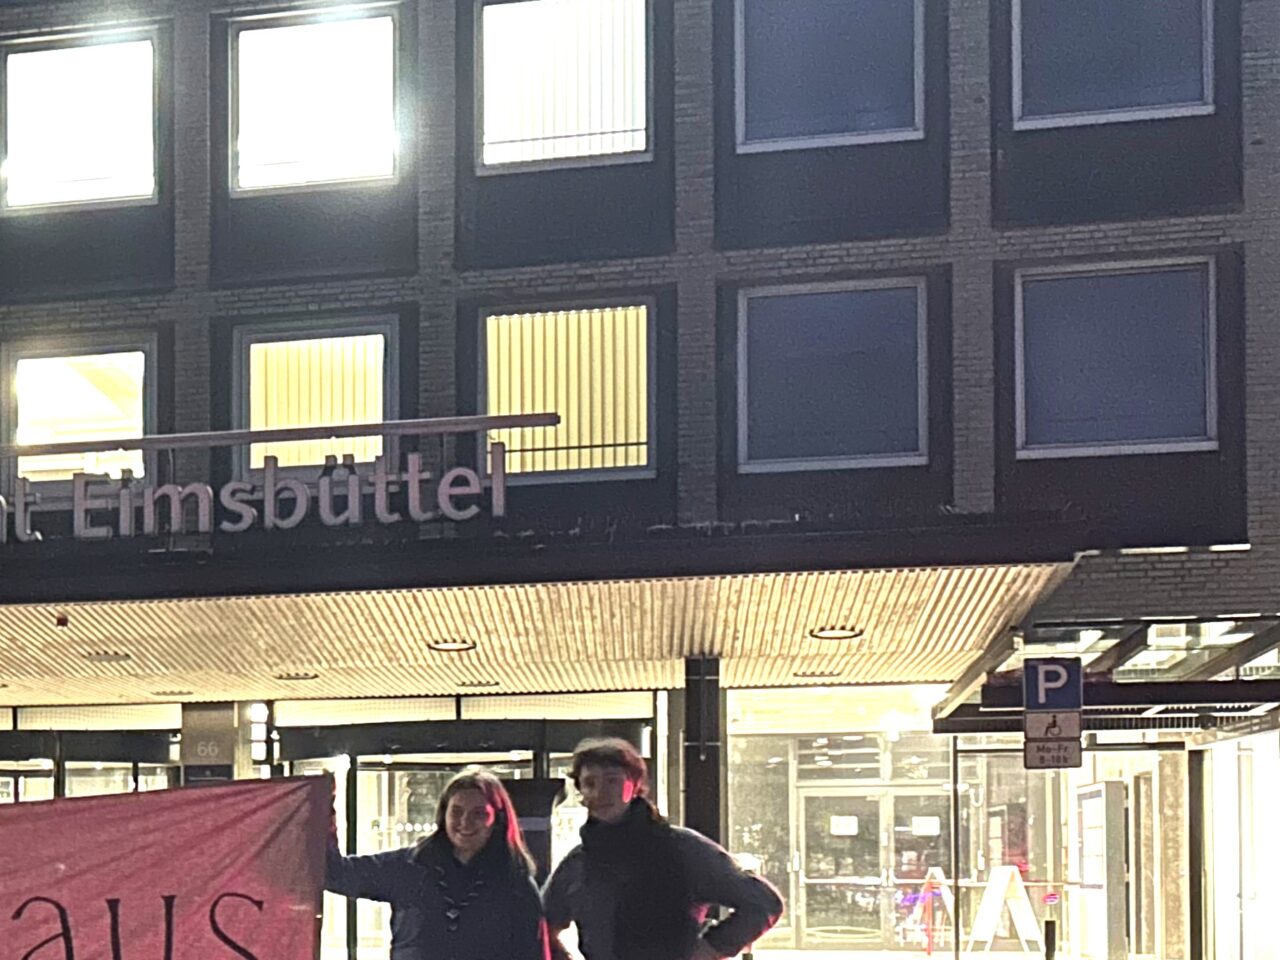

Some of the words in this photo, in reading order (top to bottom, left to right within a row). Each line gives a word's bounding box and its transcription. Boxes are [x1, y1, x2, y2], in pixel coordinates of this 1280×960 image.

[73, 441, 506, 539] Eimsbüttel
[1037, 664, 1069, 704] P
[197, 741, 218, 757] 66
